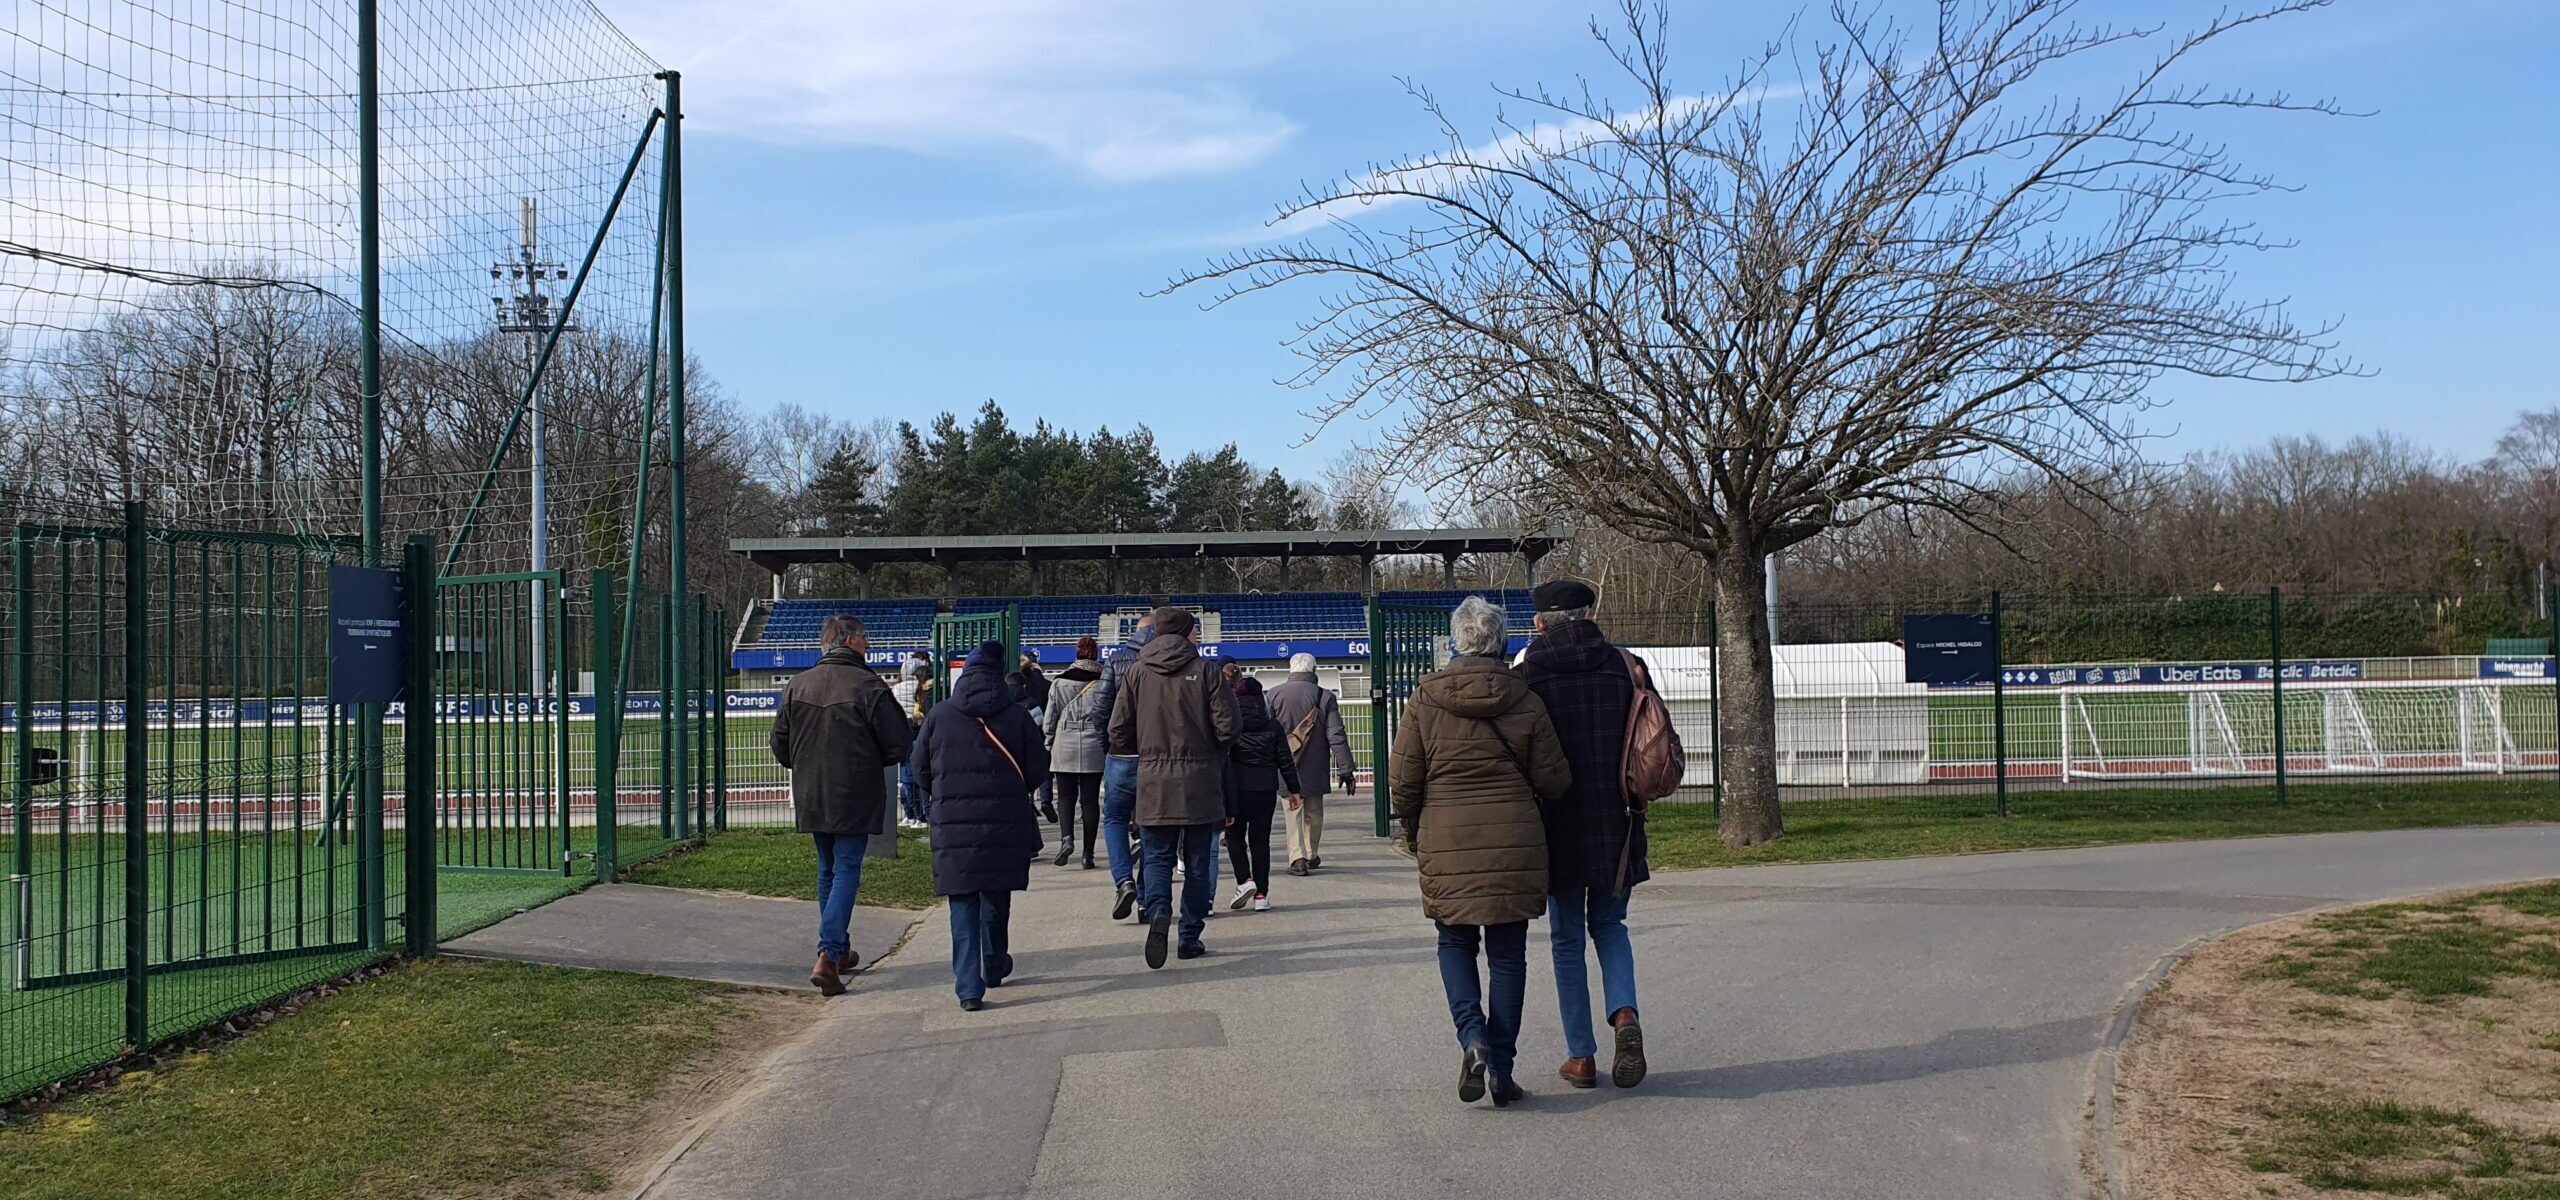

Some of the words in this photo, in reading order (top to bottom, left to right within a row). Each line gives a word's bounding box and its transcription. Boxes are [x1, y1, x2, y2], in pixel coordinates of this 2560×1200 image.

[2159, 666, 2199, 682] Uber
[2202, 665, 2242, 681] Eats
[2257, 666, 2303, 678] Beclic
[2311, 664, 2357, 678] Betclic
[726, 694, 775, 708] Orange
